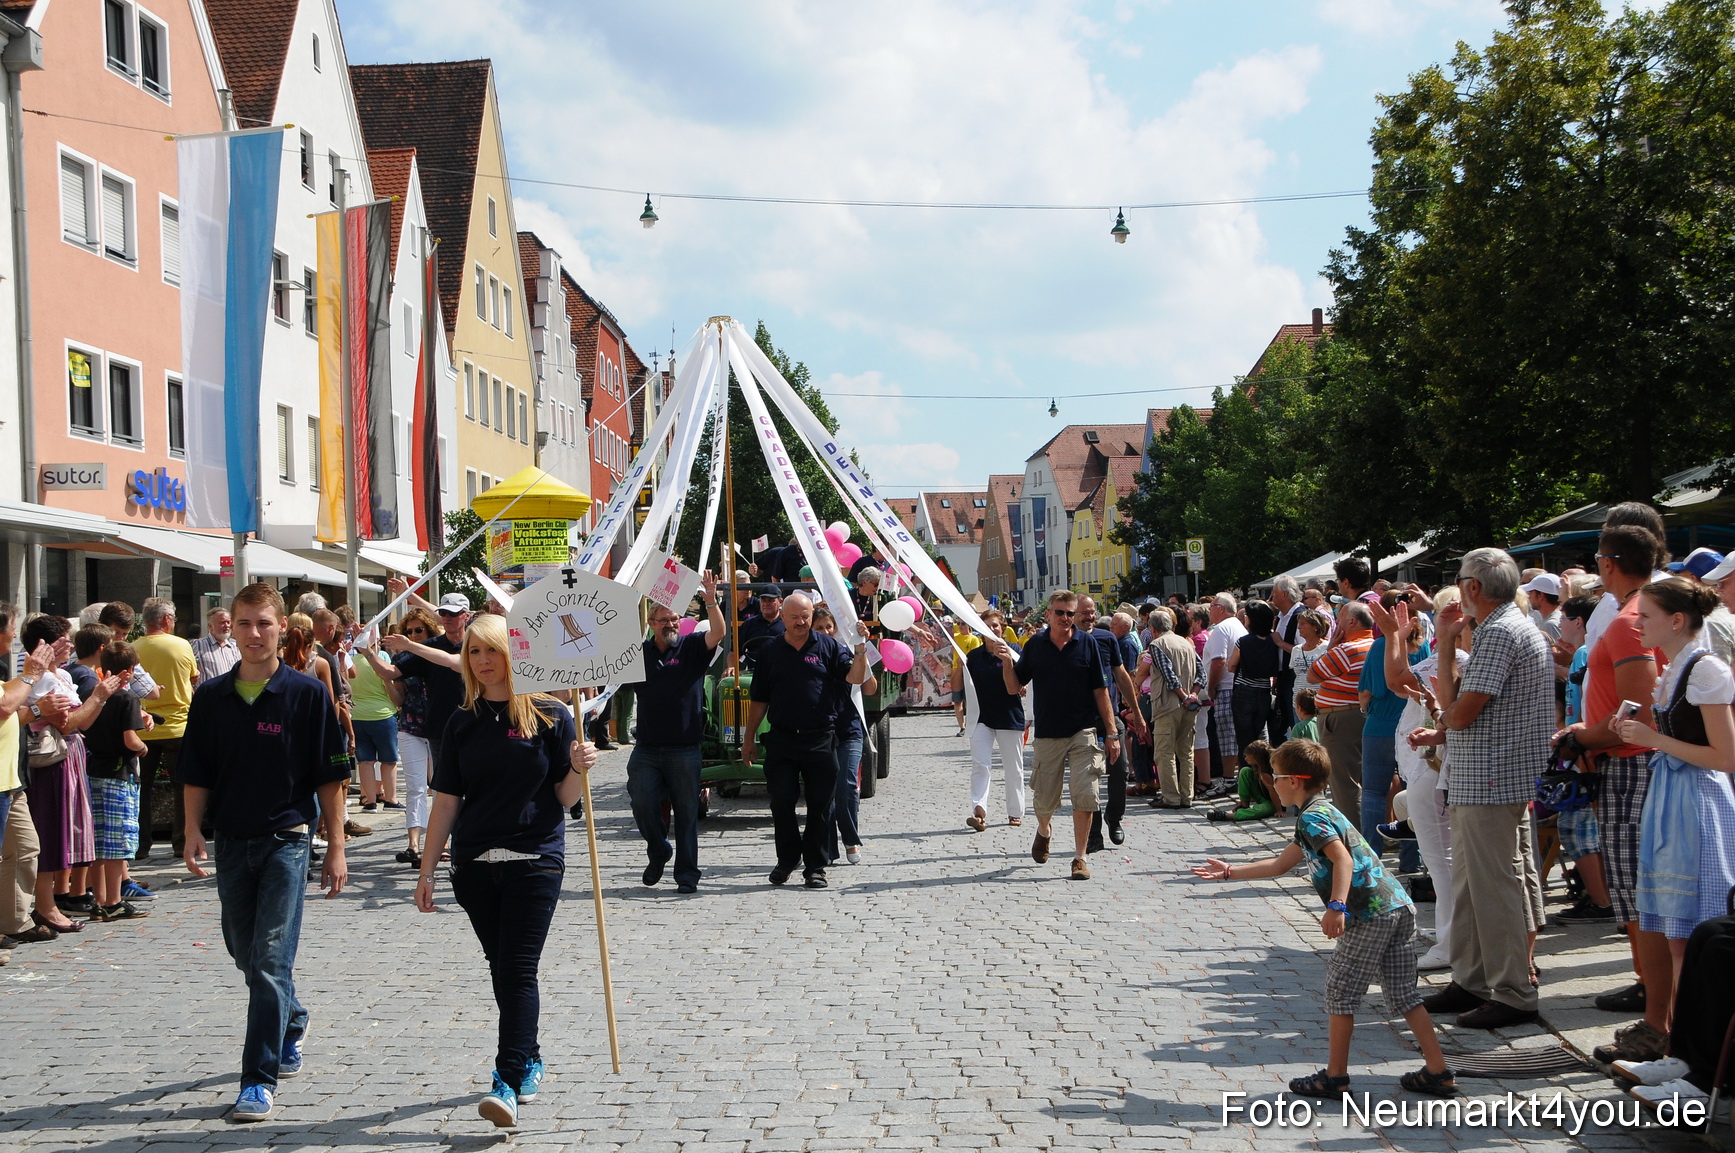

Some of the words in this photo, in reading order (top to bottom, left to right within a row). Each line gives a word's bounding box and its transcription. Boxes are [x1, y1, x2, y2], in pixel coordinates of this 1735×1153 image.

[44, 467, 101, 484] sutor.
[708, 404, 724, 508] FREYSTADT
[135, 467, 186, 512] suto
[759, 416, 826, 550] GNADENBERG
[824, 442, 910, 543] DEINING
[515, 529, 567, 538] Volksfest
[580, 466, 644, 565] DIETFU
[523, 611, 549, 638] Am
[546, 590, 618, 626] Sonntag
[512, 661, 545, 682] san
[549, 665, 582, 685] mir
[582, 641, 644, 686] dahoam
[724, 688, 749, 697] FED
[257, 722, 282, 733] KAB
